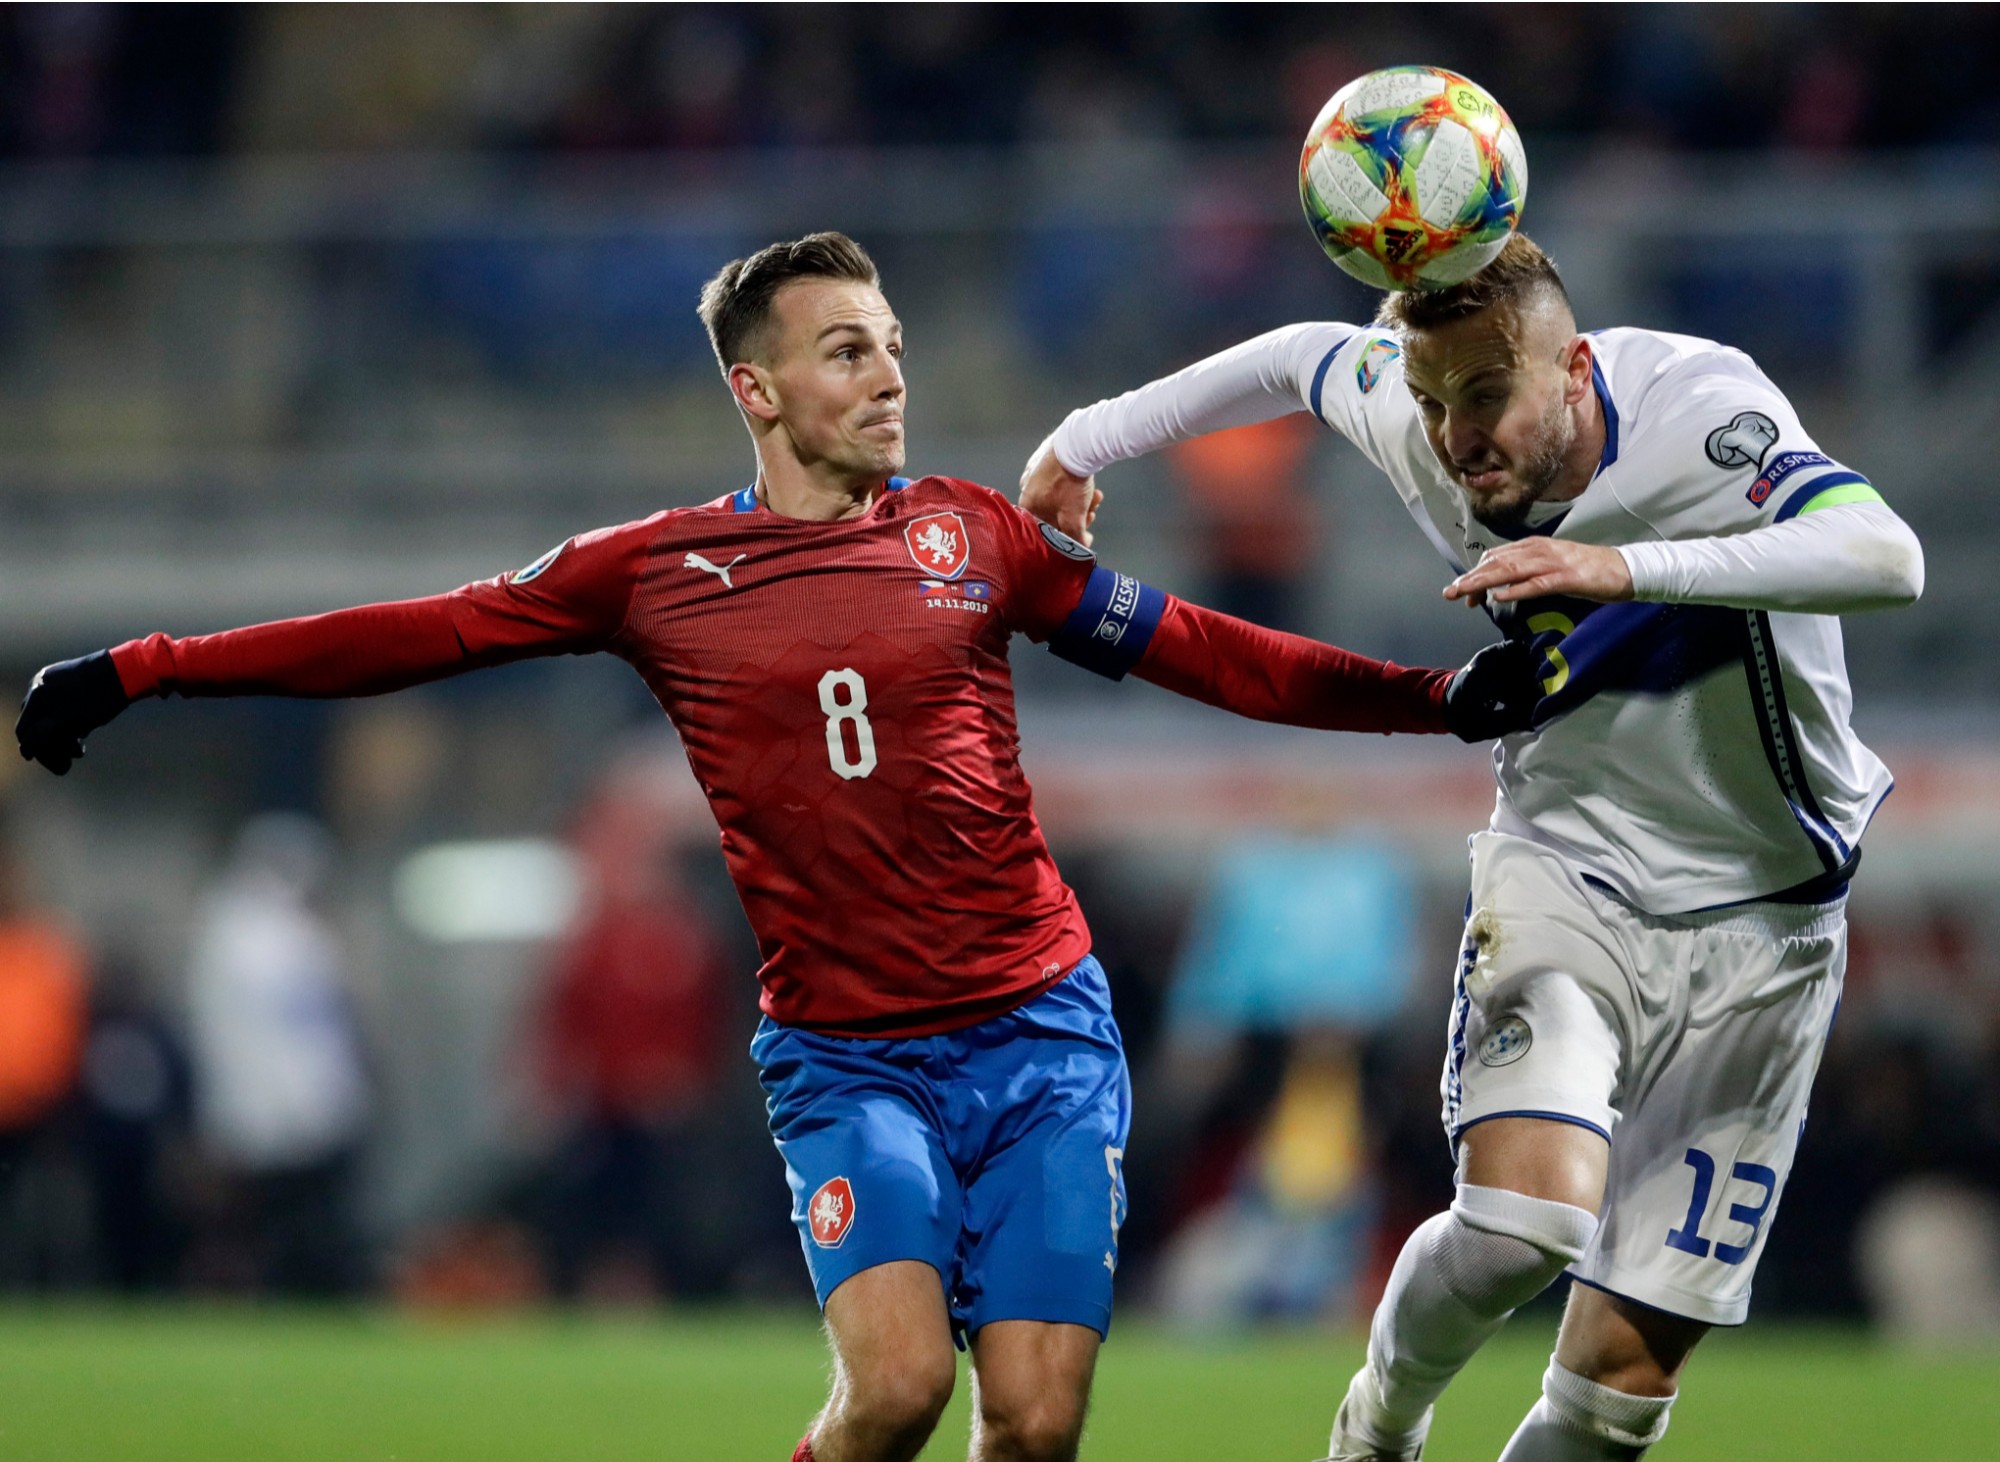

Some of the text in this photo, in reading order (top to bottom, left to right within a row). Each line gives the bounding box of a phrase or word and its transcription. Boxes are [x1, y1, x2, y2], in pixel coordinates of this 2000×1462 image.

[1767, 452, 1828, 482] RESPECT
[926, 598, 988, 614] 14.11.2019
[1112, 573, 1135, 617] RESPE
[817, 667, 878, 780] 8
[1664, 1147, 1777, 1266] 13
